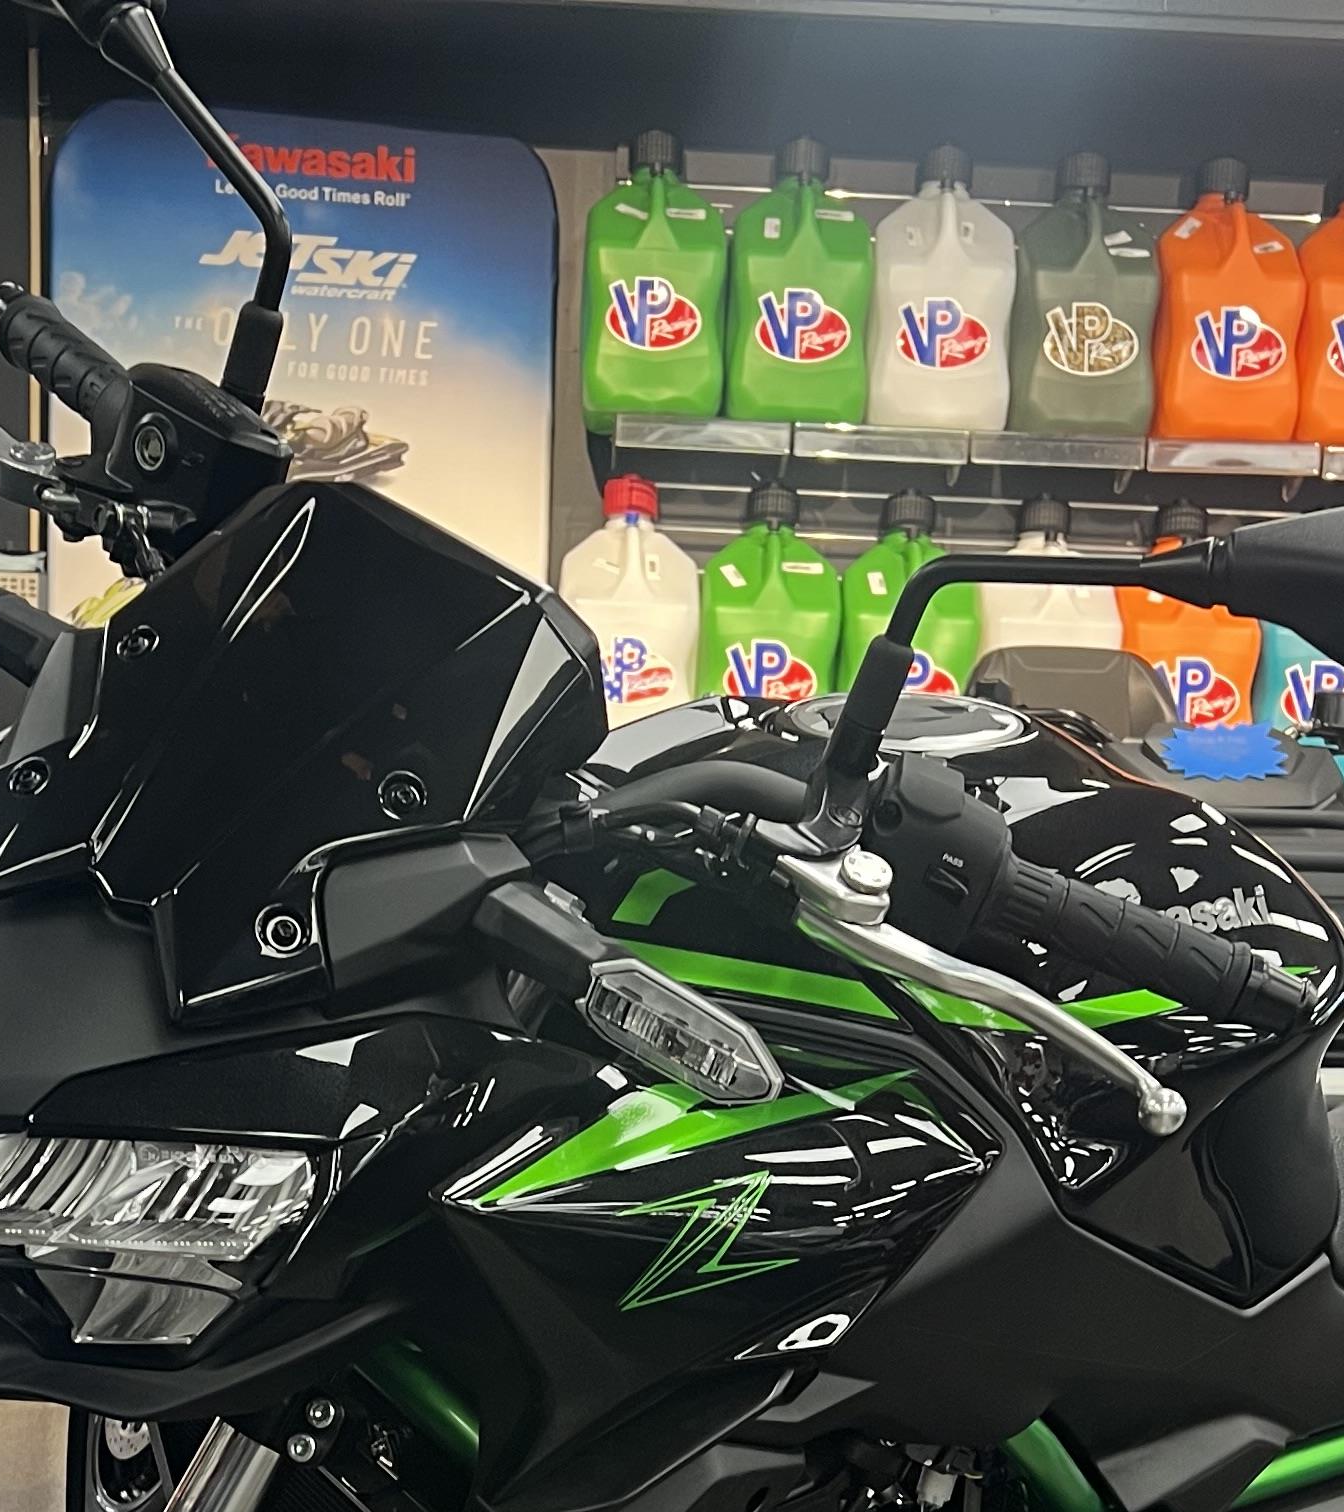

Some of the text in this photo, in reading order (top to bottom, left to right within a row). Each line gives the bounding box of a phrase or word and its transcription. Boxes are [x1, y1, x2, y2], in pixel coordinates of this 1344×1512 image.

[207, 133, 416, 183] awasaki
[275, 183, 319, 201] Good
[323, 186, 371, 205] Times
[213, 306, 329, 354] OLY
[349, 316, 439, 360] ONE
[611, 277, 673, 348] VP
[760, 289, 822, 360] VP
[900, 299, 962, 368] VP
[1046, 302, 1113, 374] VP
[1197, 308, 1259, 378] VP
[287, 360, 430, 386] FOR GOOD TIMES
[729, 641, 790, 697] VP
